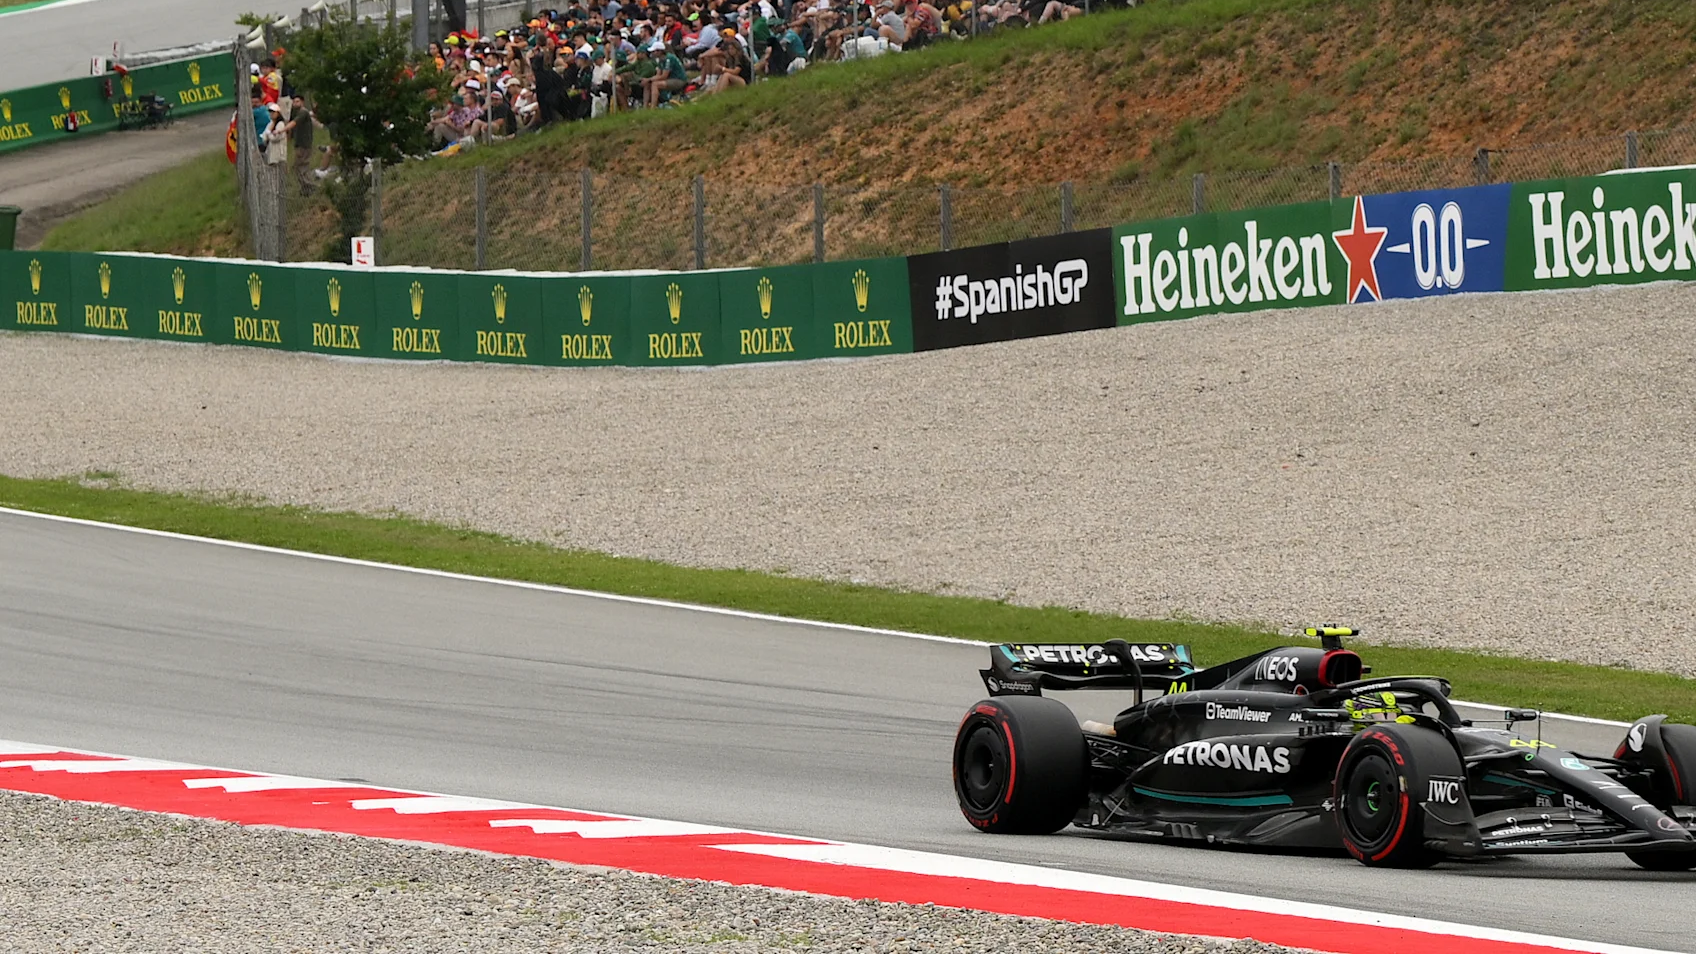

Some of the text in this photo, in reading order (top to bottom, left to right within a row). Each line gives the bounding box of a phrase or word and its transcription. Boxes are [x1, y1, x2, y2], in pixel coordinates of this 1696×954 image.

[179, 83, 223, 105] ROLEX
[1120, 220, 1332, 316] Heineken
[935, 258, 1088, 324] #SpanishGP
[16, 301, 58, 325] ROLEX
[85, 305, 128, 330] ROLEX
[158, 310, 203, 336] ROLEX
[233, 317, 281, 343] ROLEX
[313, 323, 360, 349] ROLEX
[392, 327, 441, 354] ROLEX
[740, 327, 795, 355] ROLEX
[833, 320, 892, 349] ROLEX
[476, 331, 527, 358] ROLEX
[561, 334, 613, 359] ROLEX
[648, 333, 703, 359] ROLEX
[1255, 656, 1299, 682] INEOS
[1214, 703, 1272, 723] TeamViewer
[1163, 741, 1291, 774] PETRONAS
[1427, 780, 1459, 804] IWC
[1491, 825, 1544, 837] PETRONAS
